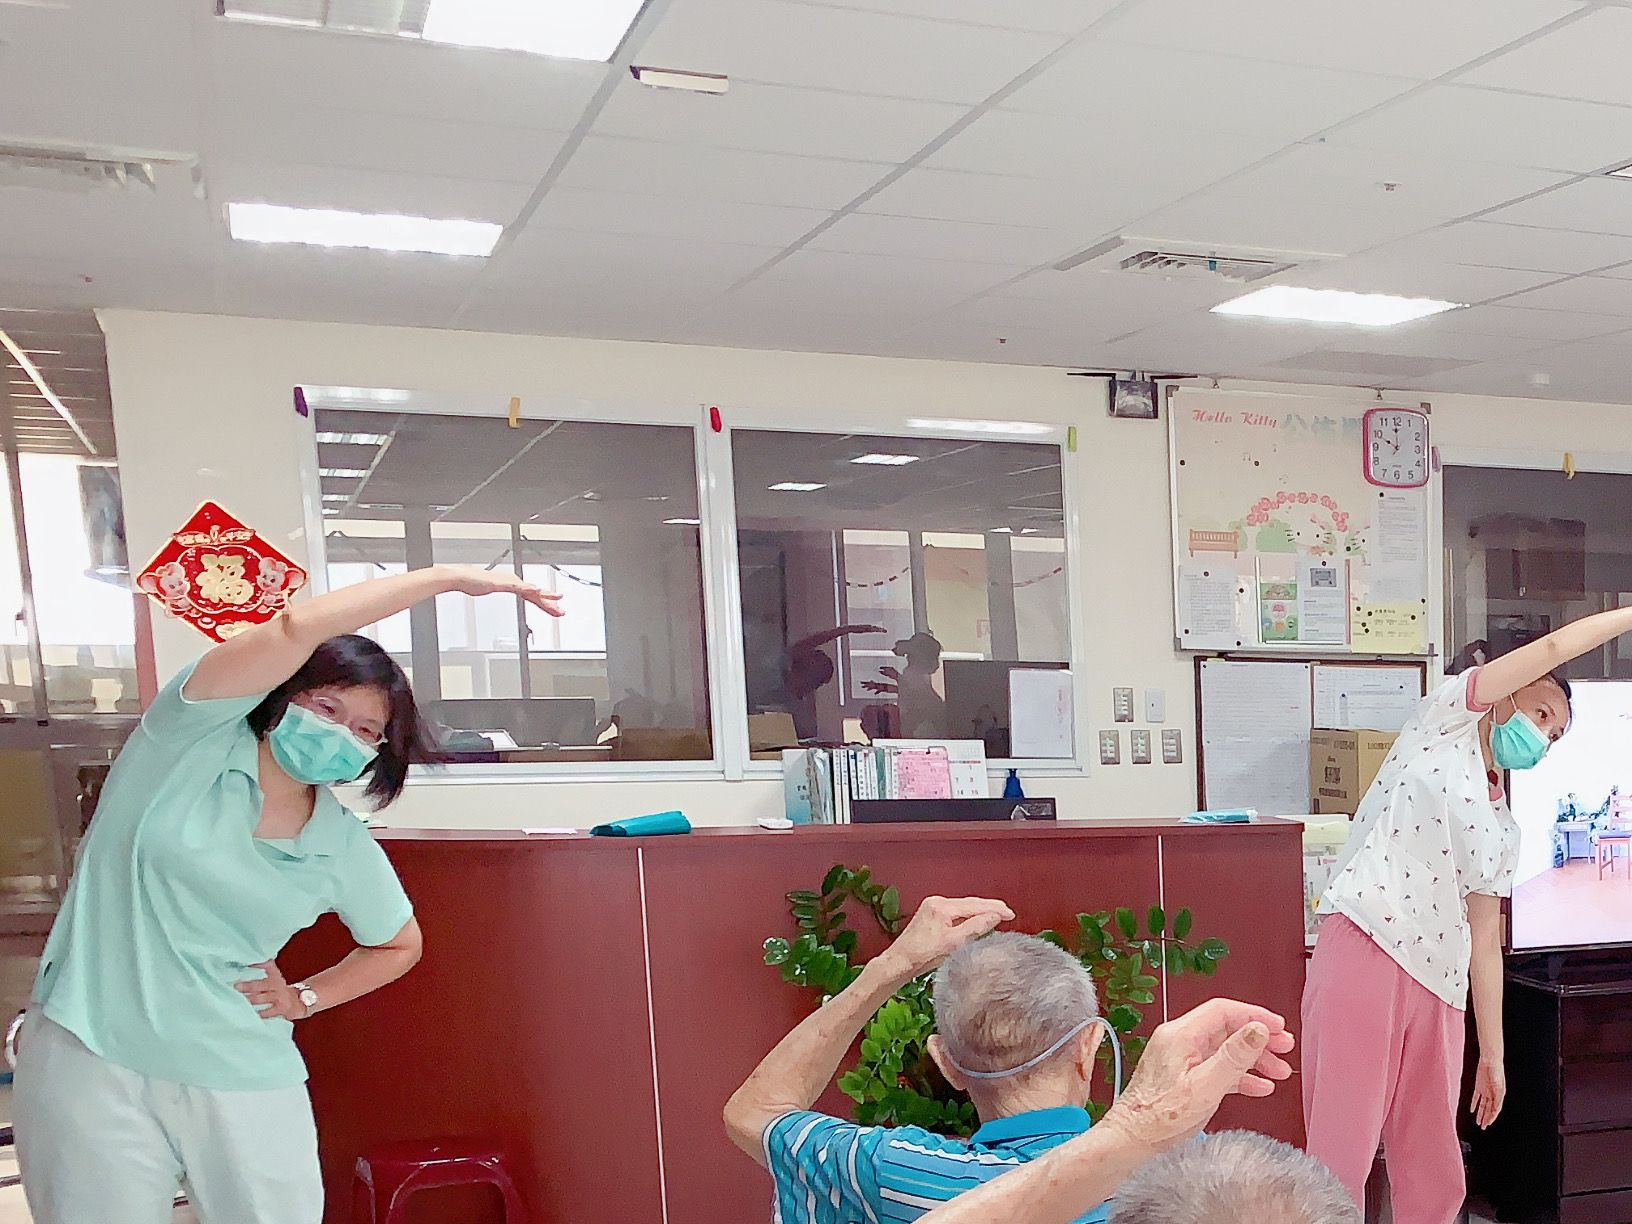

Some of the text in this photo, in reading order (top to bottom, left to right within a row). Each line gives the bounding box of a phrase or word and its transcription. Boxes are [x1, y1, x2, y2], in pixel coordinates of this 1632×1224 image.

[1192, 409, 1233, 424] Hello
[1239, 412, 1277, 428] Kitty
[1380, 418, 1388, 427] 11
[1392, 417, 1402, 427] 12
[1374, 430, 1383, 439] 10
[1414, 432, 1421, 441] 2
[1373, 442, 1379, 452] 9
[1414, 445, 1421, 454] 3
[1373, 456, 1379, 466] 8
[1381, 468, 1388, 478] 7
[1394, 471, 1400, 480] 6
[1408, 470, 1414, 479] 5
[195, 553, 254, 604] 福
